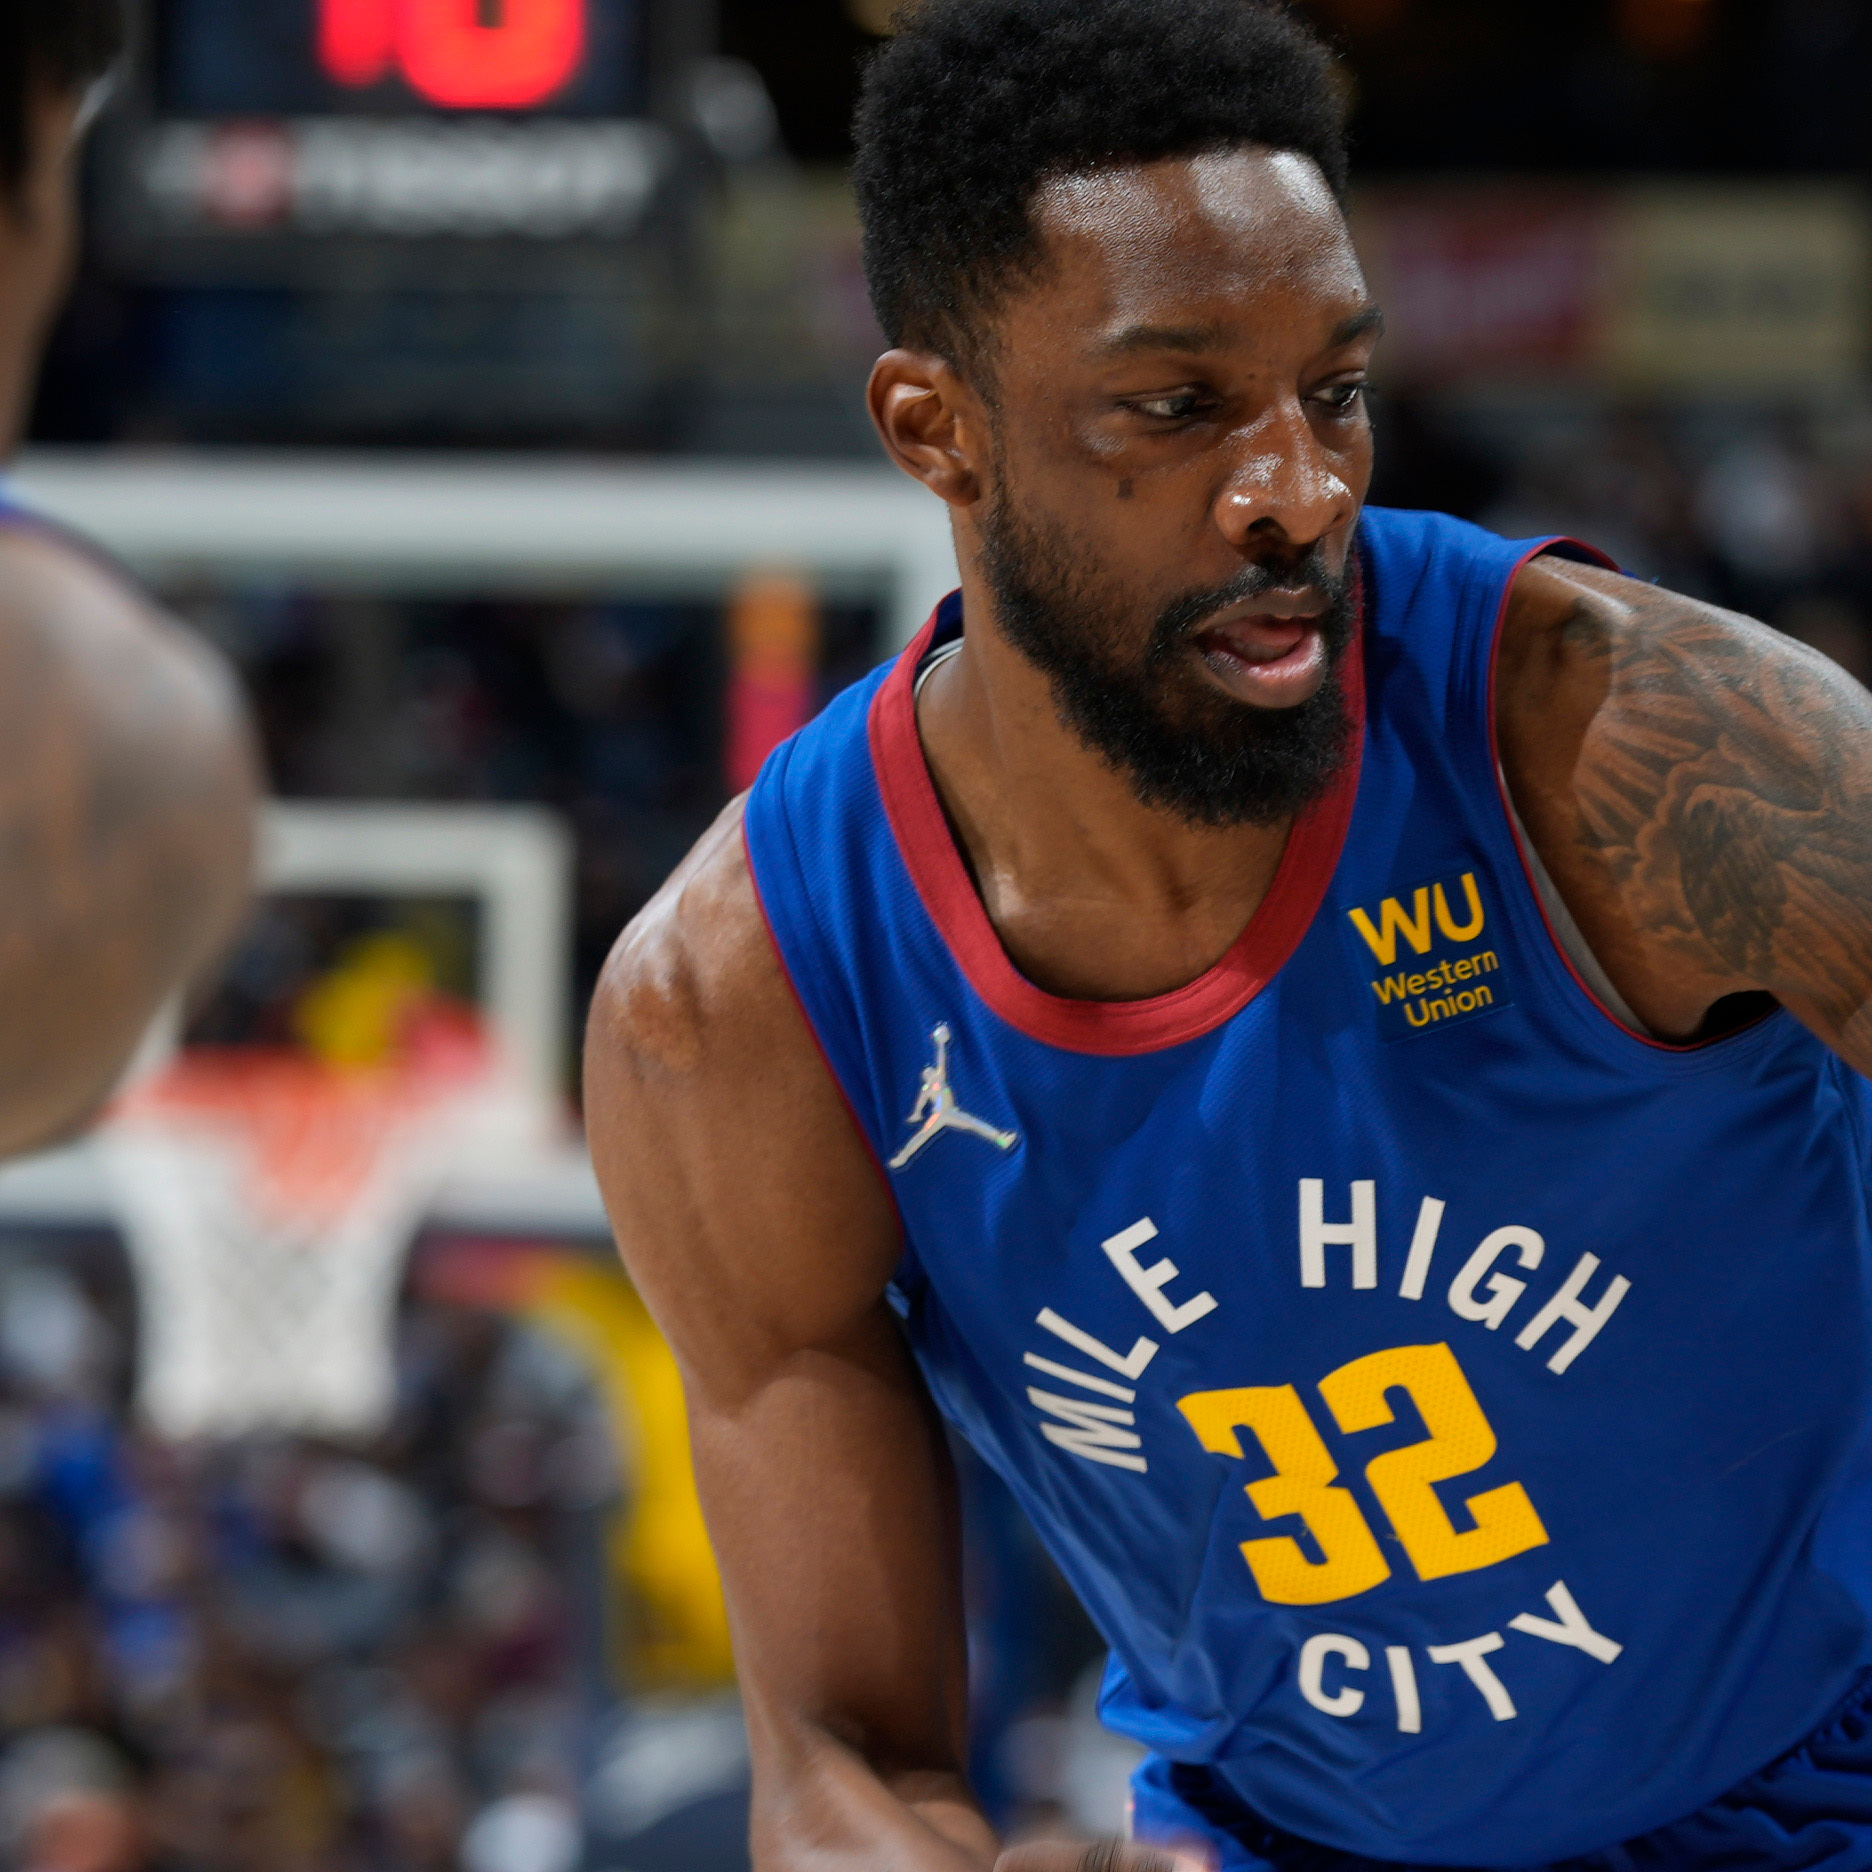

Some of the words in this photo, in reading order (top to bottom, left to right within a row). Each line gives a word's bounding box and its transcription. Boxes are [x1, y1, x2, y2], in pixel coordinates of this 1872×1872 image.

[1348, 872, 1485, 967] WU
[1371, 950, 1500, 1006] Western
[1403, 984, 1494, 1028] Union
[1023, 1216, 1219, 1474] MILE
[1298, 1177, 1632, 1376] HIGH
[1176, 1340, 1551, 1606] 32
[1297, 1579, 1624, 1735] CITY
